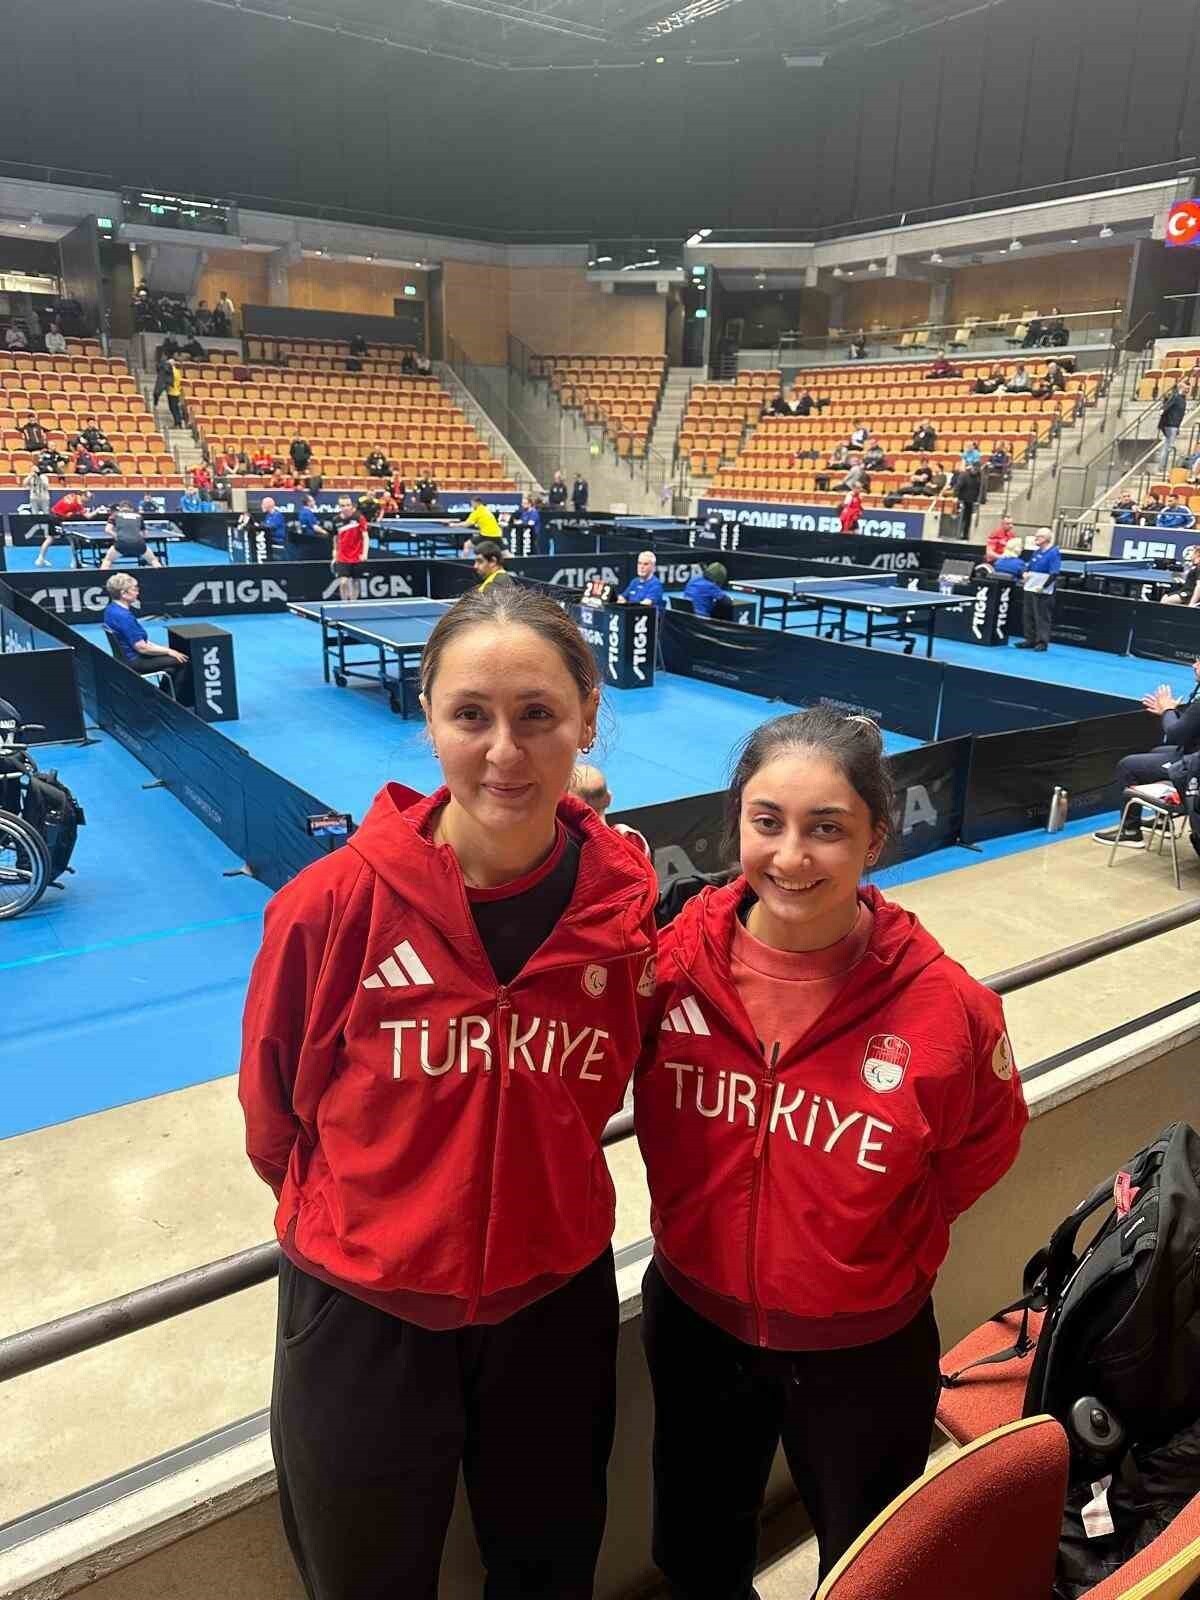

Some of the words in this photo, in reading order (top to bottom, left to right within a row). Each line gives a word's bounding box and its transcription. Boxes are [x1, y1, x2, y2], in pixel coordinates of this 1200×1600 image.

[183, 579, 288, 606] STIGA
[321, 575, 414, 600] SIGA
[972, 586, 989, 640] STIGA
[996, 587, 1012, 640] STIGA
[608, 614, 620, 681] STIGA
[632, 615, 649, 681] STIGA
[203, 646, 224, 715] STIGA
